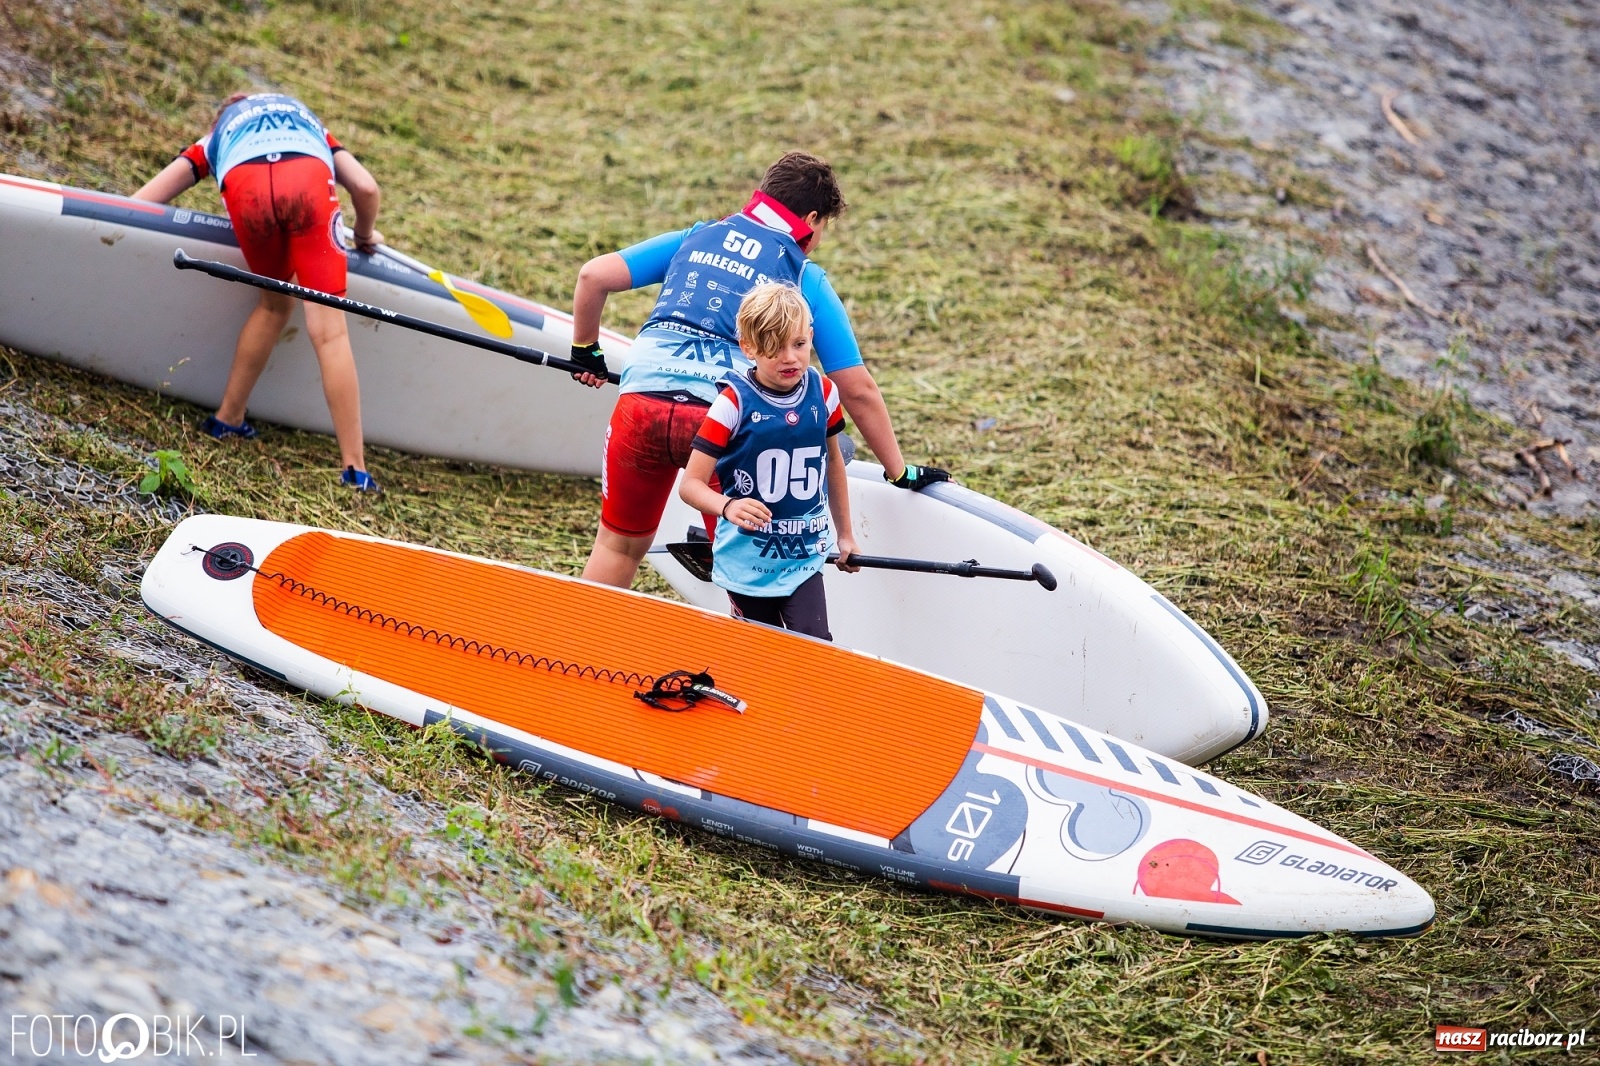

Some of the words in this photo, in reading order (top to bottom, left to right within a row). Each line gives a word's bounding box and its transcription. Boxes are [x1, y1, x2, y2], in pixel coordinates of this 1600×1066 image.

[722, 229, 763, 260] 50
[688, 250, 755, 281] MAŁECKI
[657, 366, 688, 375] AQUA
[756, 446, 821, 503] 05
[751, 565, 776, 574] AQUA
[780, 565, 816, 573] MARINA
[701, 817, 734, 832] LENGTH
[797, 843, 824, 855] WIDTH
[879, 864, 916, 878] VOLUME
